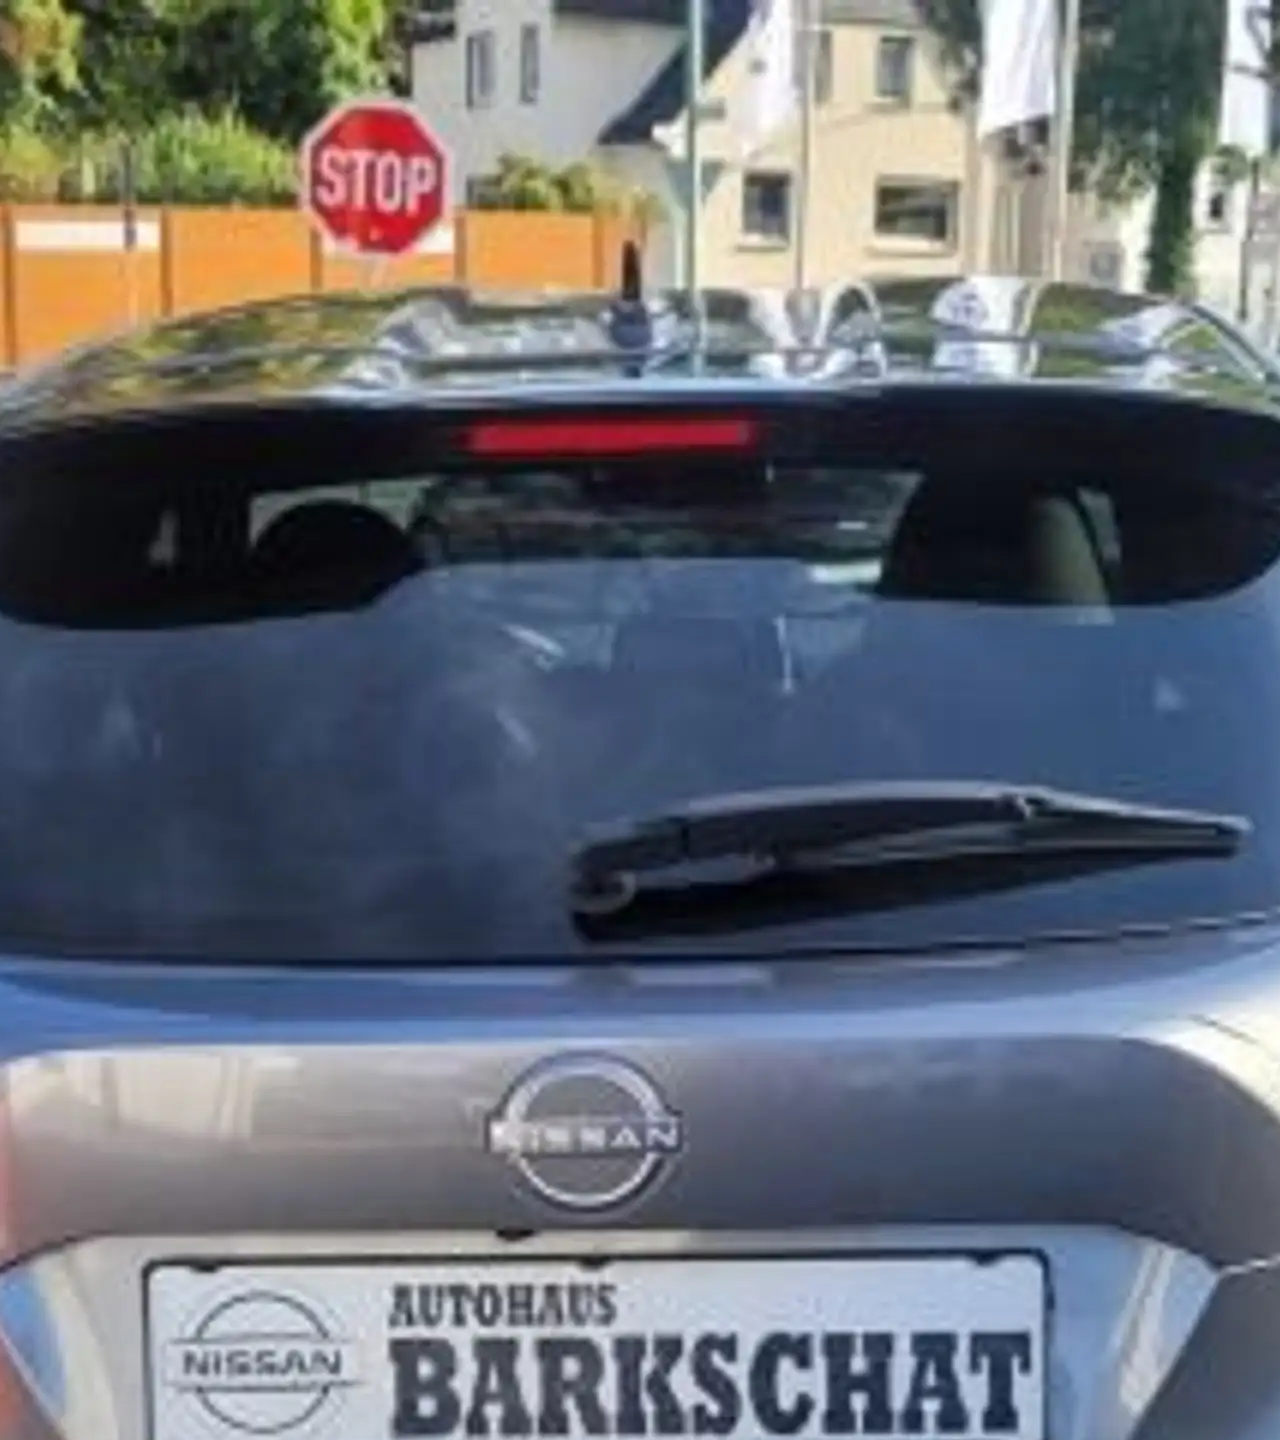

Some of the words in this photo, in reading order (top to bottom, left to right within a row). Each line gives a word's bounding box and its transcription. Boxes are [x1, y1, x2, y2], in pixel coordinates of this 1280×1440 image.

[316, 144, 437, 217] STOP
[489, 1122, 678, 1152] NISSAN
[388, 1283, 617, 1328] AUTOHAUS
[181, 1348, 344, 1377] NISSAN
[387, 1330, 1032, 1438] BARKSCHAT
